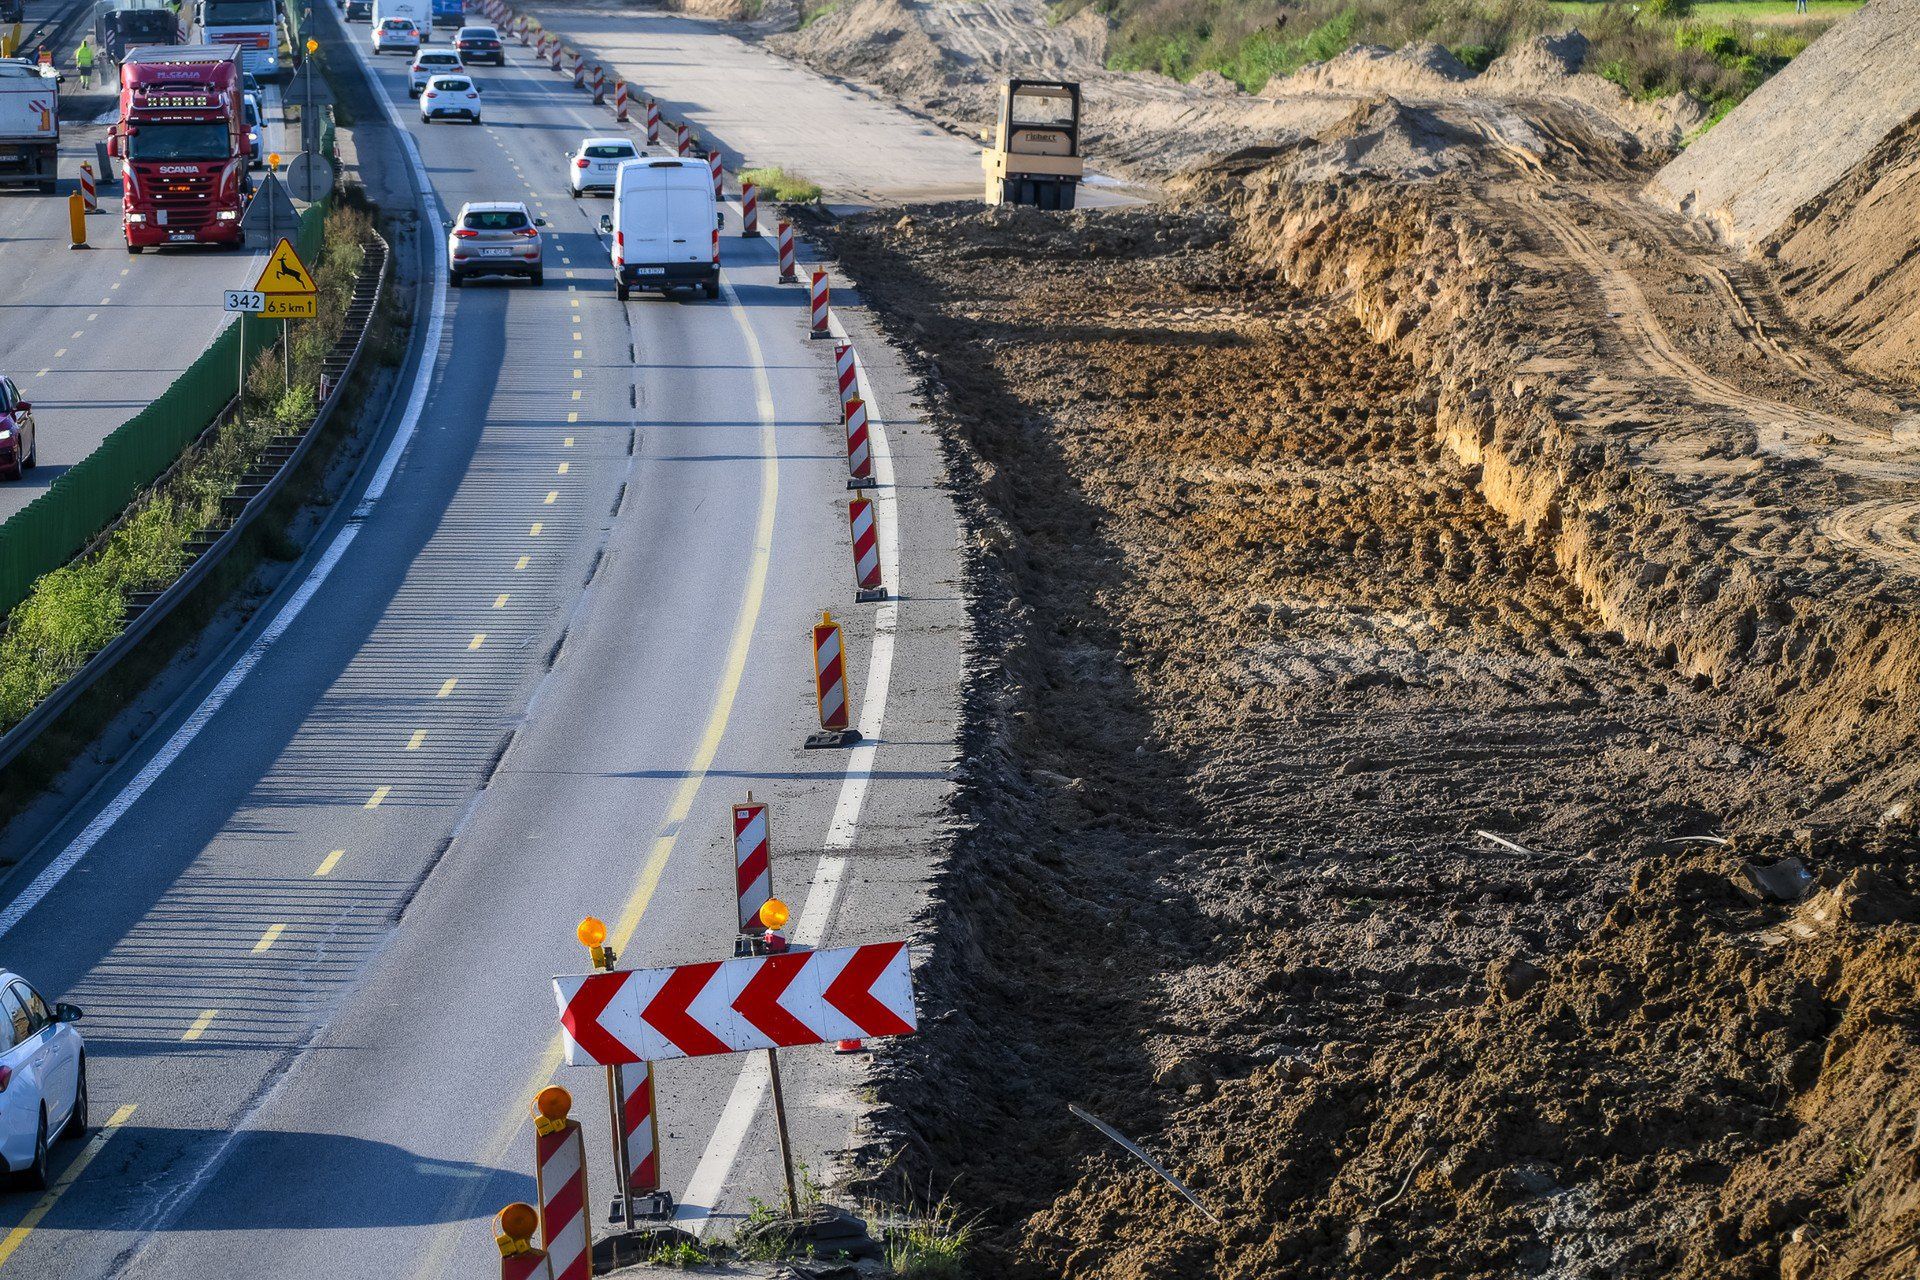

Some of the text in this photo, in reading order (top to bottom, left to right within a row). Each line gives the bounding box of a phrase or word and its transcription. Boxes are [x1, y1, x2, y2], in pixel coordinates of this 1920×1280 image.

[159, 165, 199, 174] SCANIA
[229, 294, 260, 309] 342
[267, 301, 305, 314] 6,5 km
